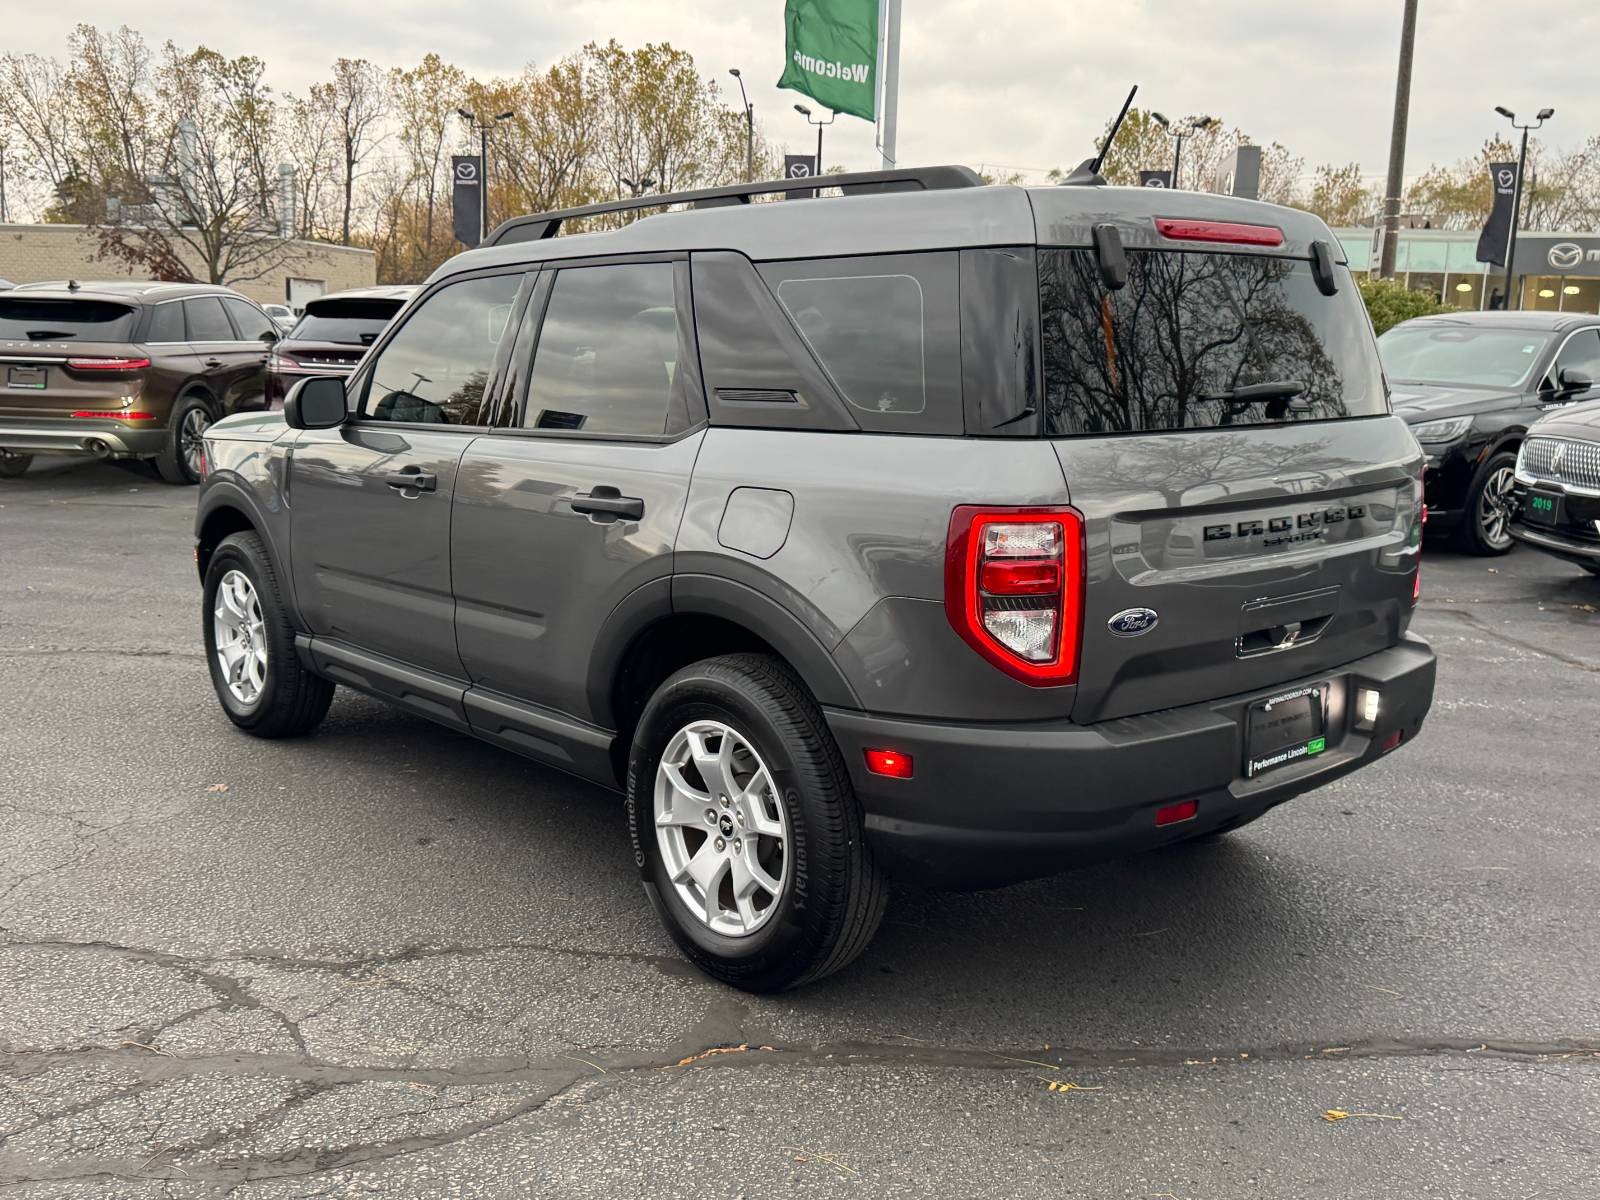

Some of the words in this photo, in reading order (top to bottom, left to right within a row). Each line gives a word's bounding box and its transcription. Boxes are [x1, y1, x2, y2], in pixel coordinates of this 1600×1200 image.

[1532, 497, 1552, 511] 2019
[1203, 505, 1367, 541] BRONCO
[1253, 752, 1287, 771] Performance
[1288, 746, 1307, 759] Lincoln
[786, 787, 808, 898] Continental
